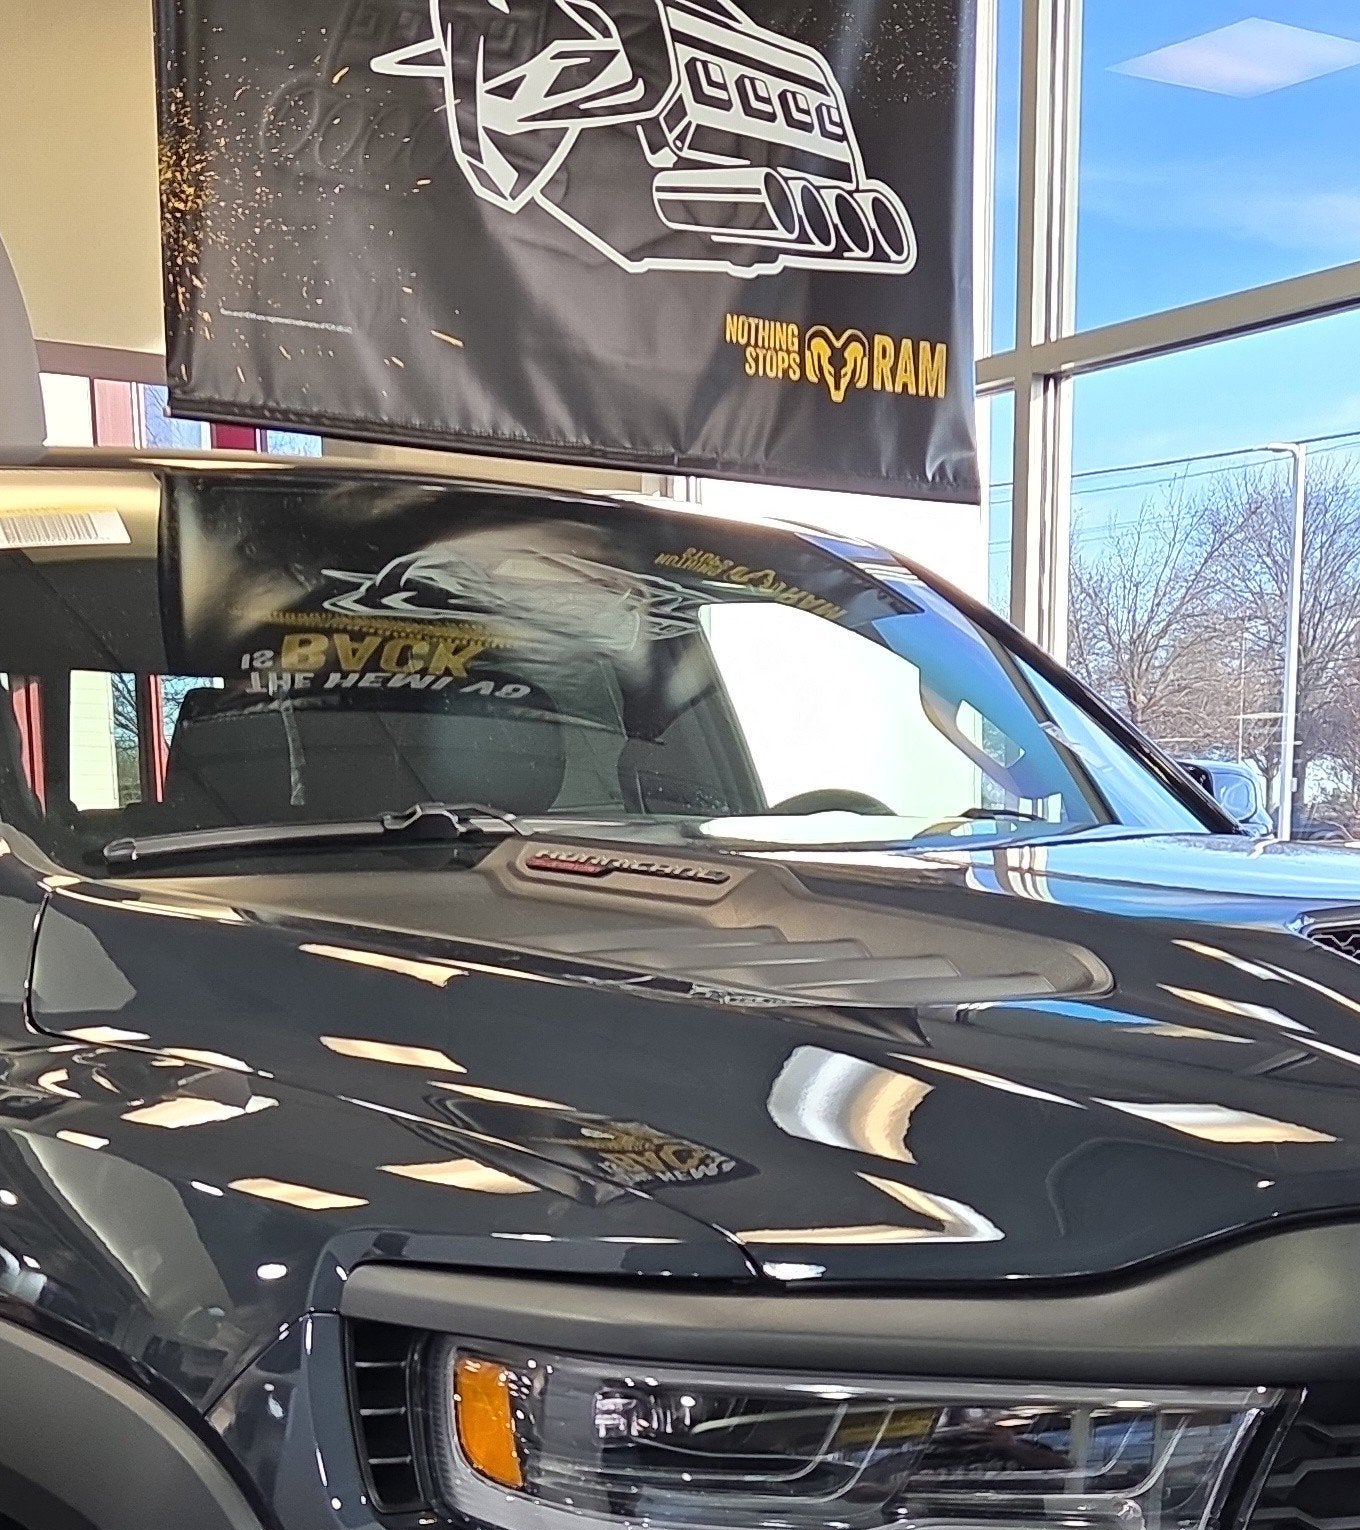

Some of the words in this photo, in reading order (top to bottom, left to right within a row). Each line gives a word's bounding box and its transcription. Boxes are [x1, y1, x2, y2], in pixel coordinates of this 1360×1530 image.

[725, 313, 799, 351] NOTHING
[745, 346, 801, 381] STOPS
[872, 333, 947, 399] RAM
